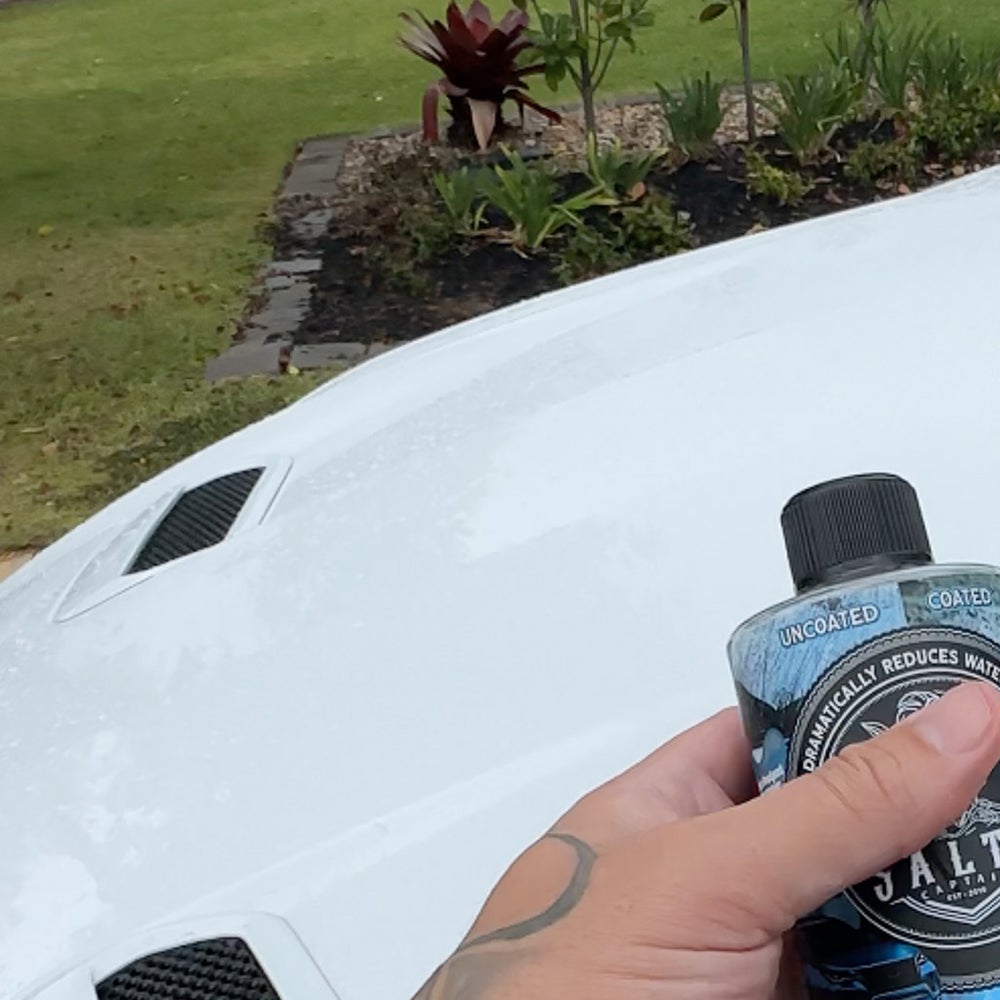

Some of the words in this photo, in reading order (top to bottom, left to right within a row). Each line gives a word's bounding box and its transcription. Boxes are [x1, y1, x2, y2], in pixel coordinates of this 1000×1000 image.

[927, 587, 992, 610] COATED
[779, 604, 880, 648] UNCOATED
[802, 664, 878, 773] DRAMATICALLY
[881, 648, 958, 675] REDUCES
